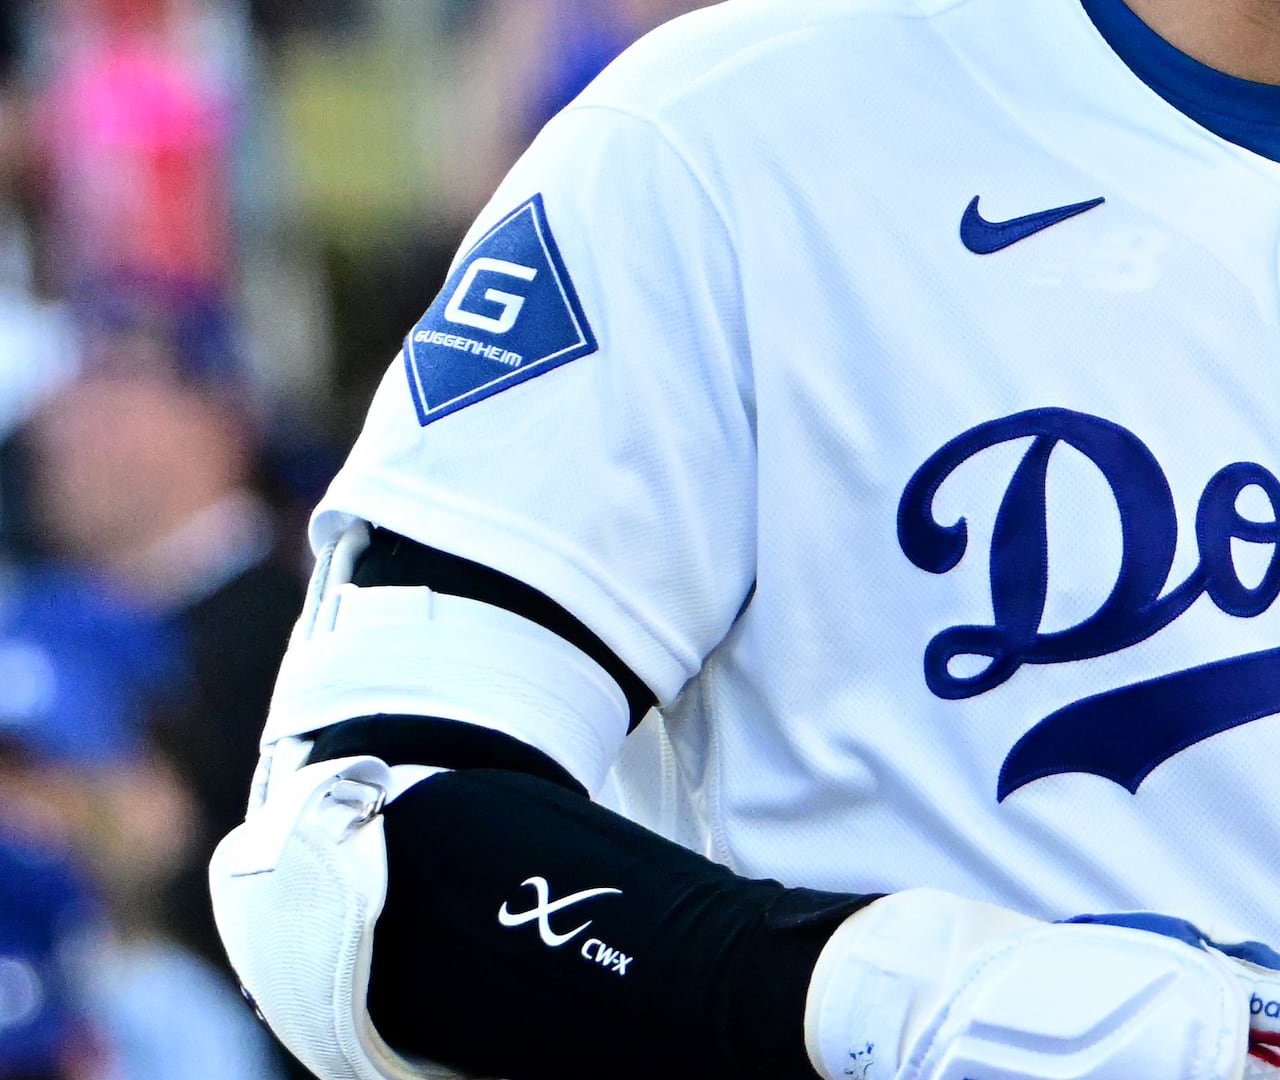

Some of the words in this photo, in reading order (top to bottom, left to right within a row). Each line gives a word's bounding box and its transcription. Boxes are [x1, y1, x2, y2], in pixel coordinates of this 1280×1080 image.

[443, 256, 538, 335] G
[414, 329, 523, 368] GUGGENHEIM
[581, 938, 634, 976] CW-X
